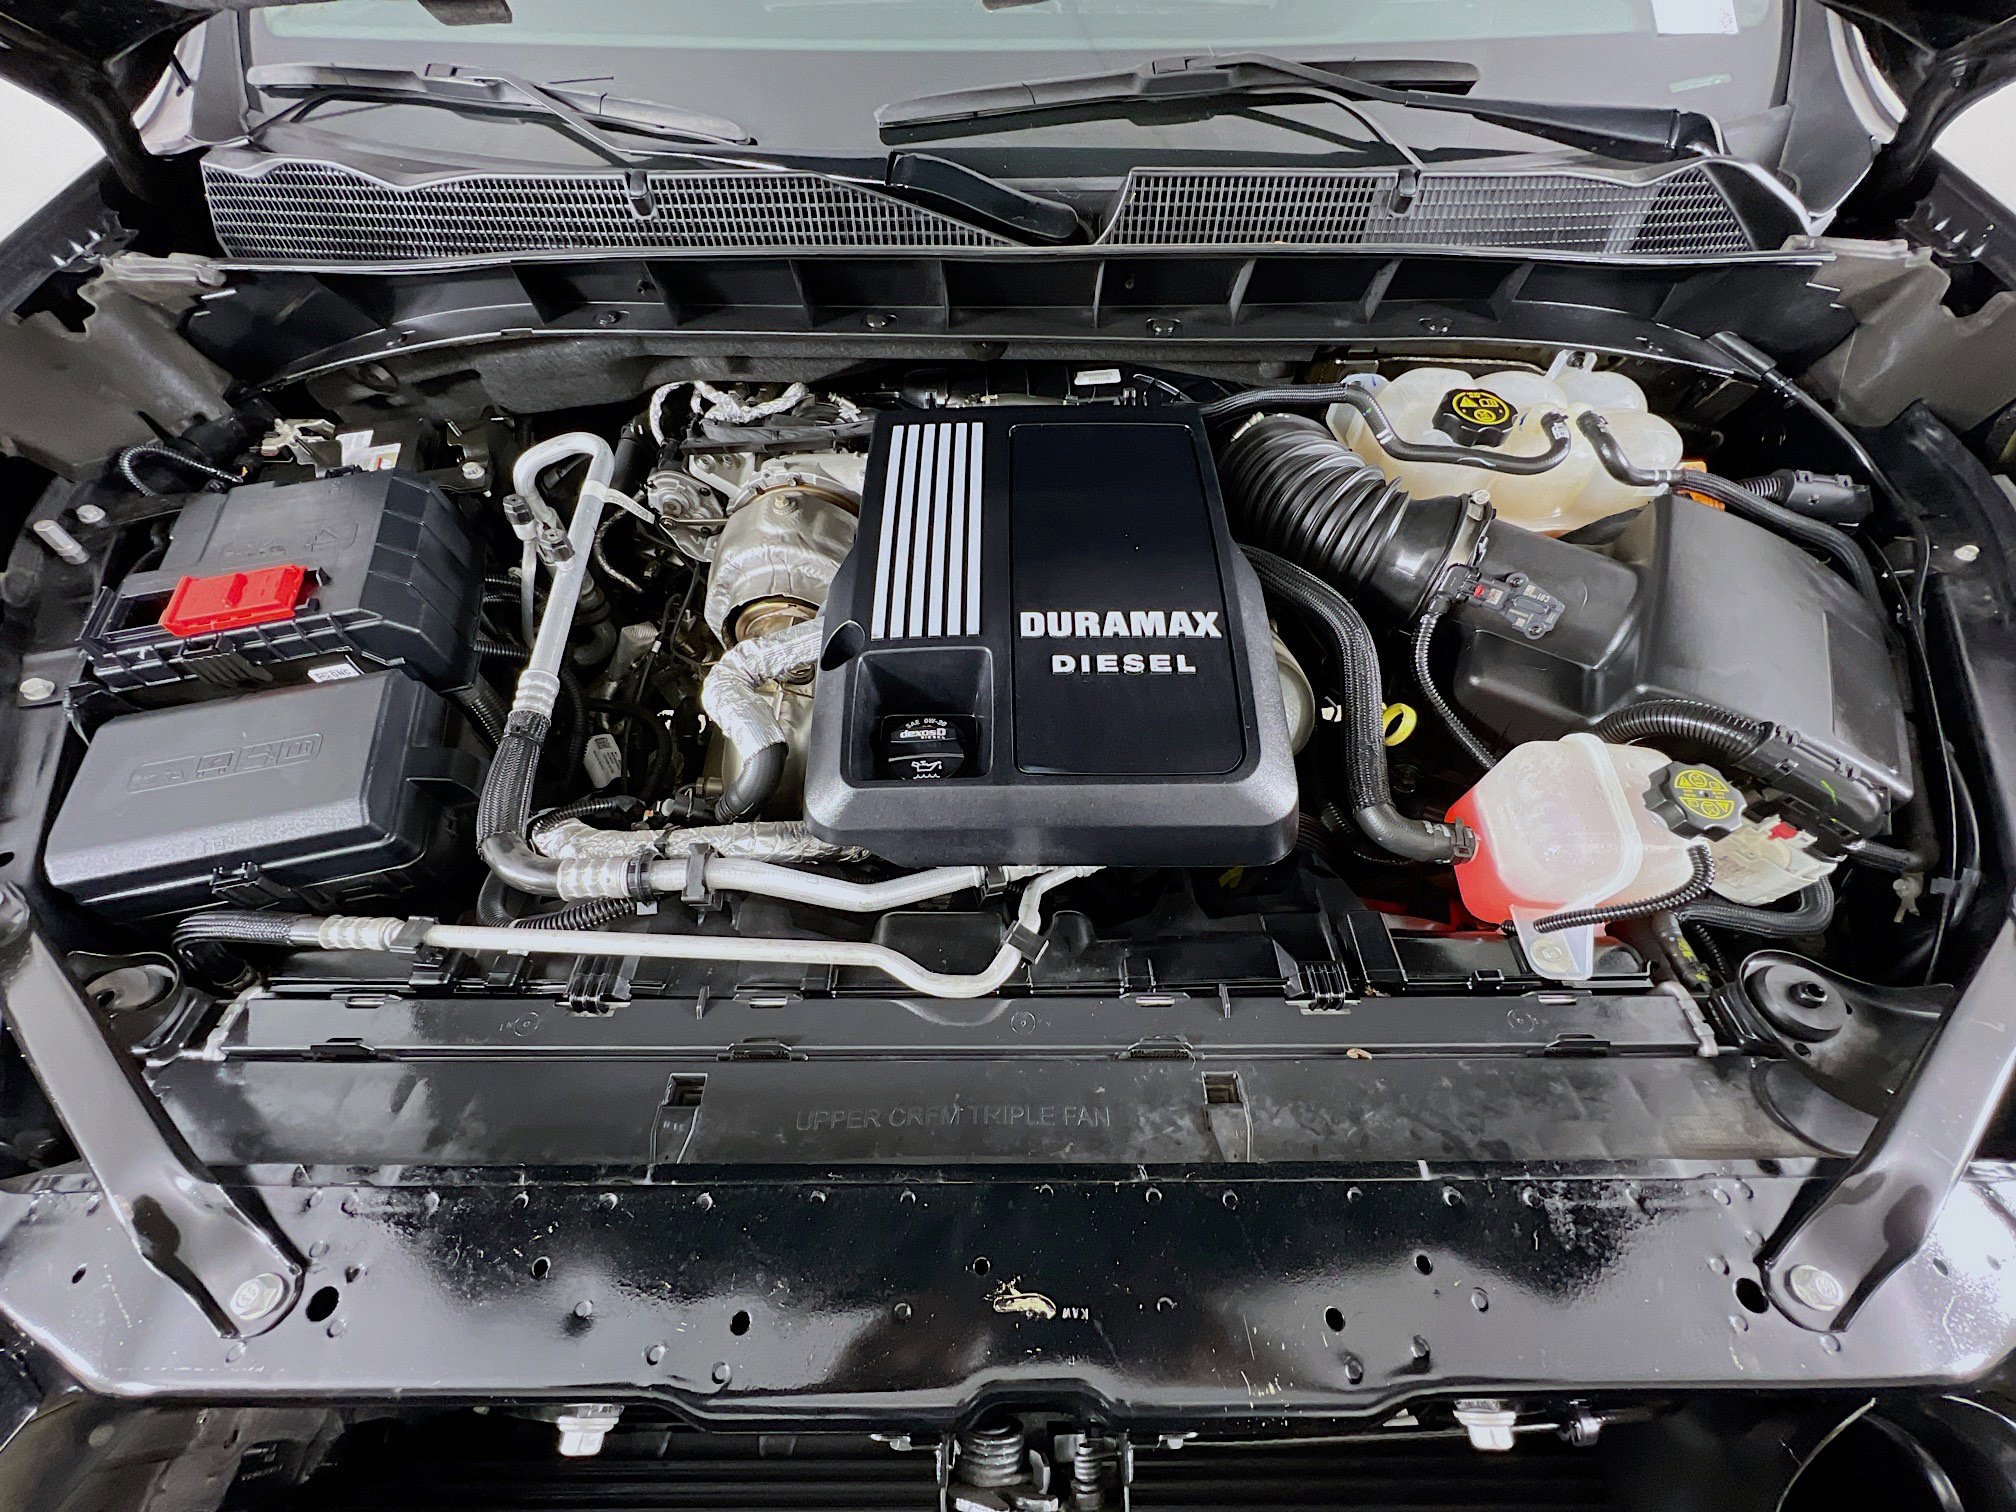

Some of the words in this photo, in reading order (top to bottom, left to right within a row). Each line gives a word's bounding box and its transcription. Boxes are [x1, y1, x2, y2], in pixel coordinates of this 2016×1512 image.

[1019, 611, 1222, 639] DURAMAX
[1051, 653, 1196, 675] DIESEL
[905, 719, 920, 729] SAE
[796, 1109, 882, 1131] UPPER
[888, 1105, 960, 1127] CRFM
[963, 1104, 1055, 1126] TRIPLE
[1063, 1104, 1111, 1127] FAN
